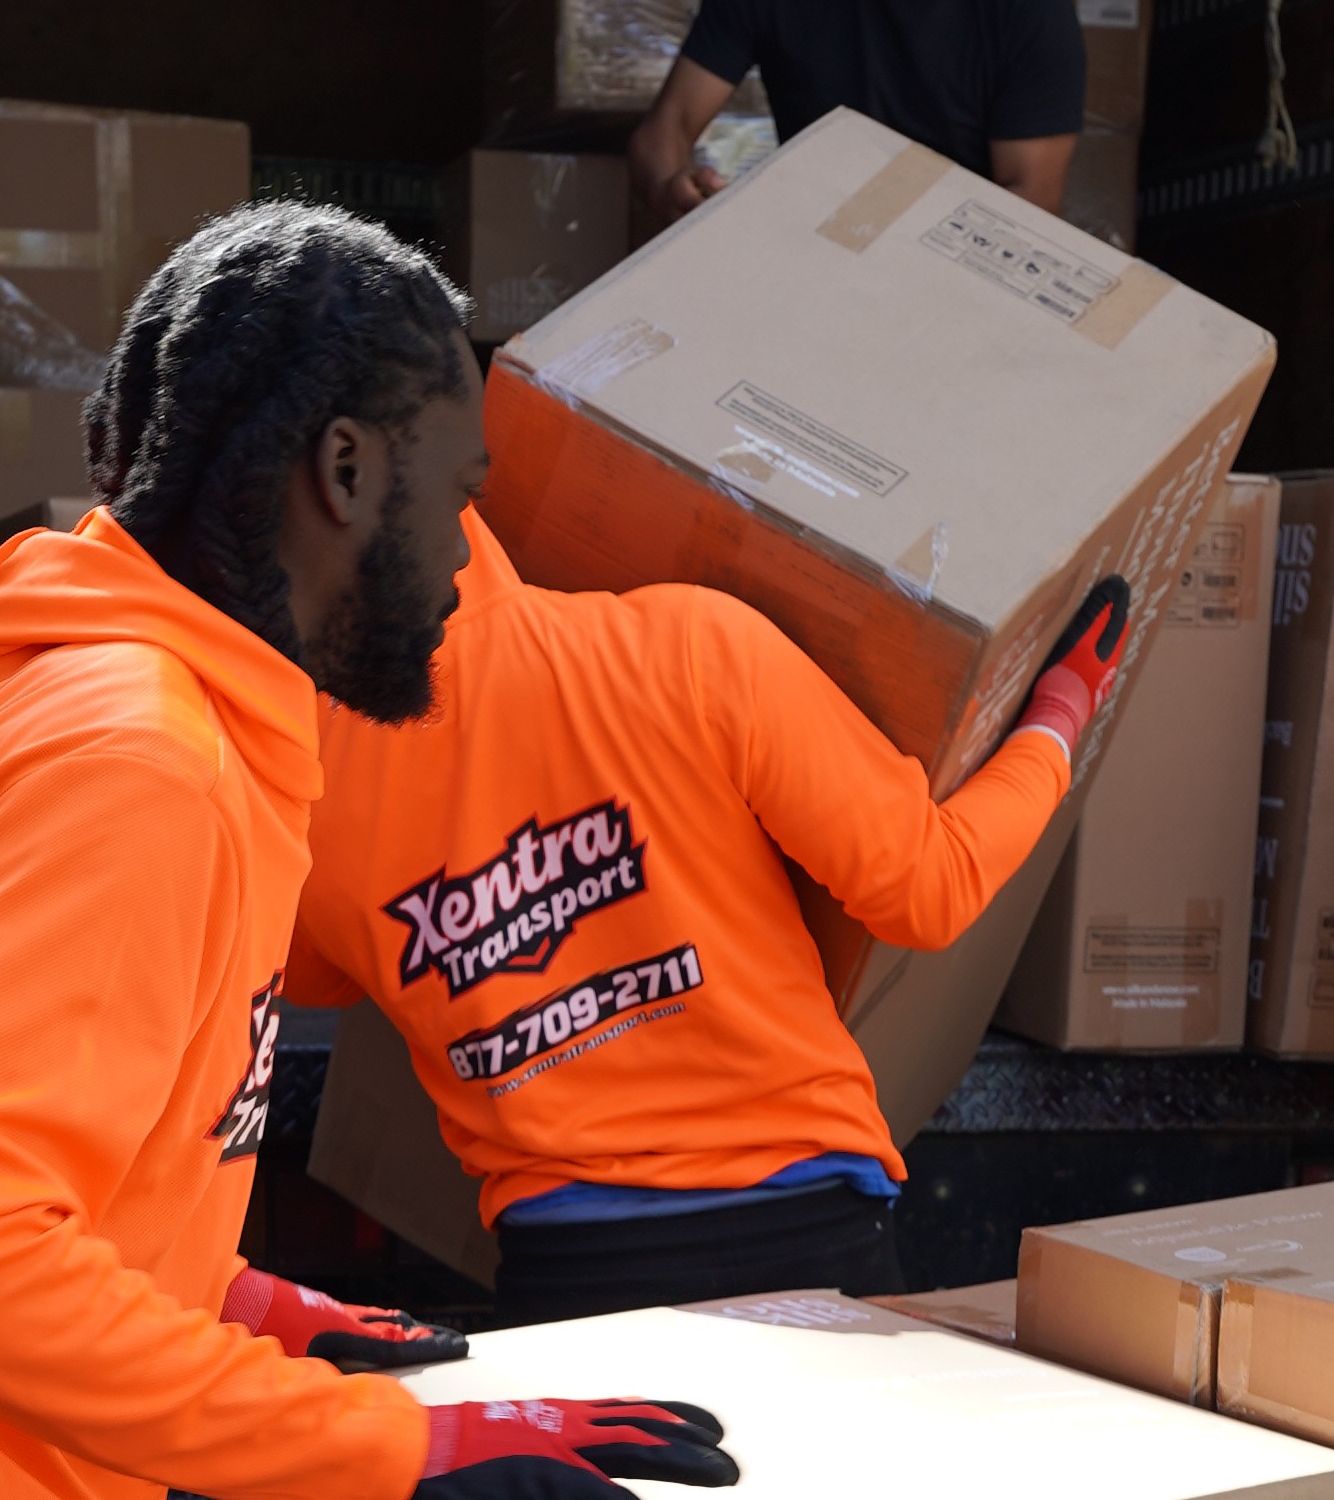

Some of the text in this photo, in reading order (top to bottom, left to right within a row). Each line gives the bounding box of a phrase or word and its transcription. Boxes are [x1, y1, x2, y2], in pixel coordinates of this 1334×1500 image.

[1273, 570, 1312, 626] sil
[399, 809, 624, 970] Xentra
[442, 856, 637, 987] Transport
[450, 949, 702, 1079] 877-709-2711
